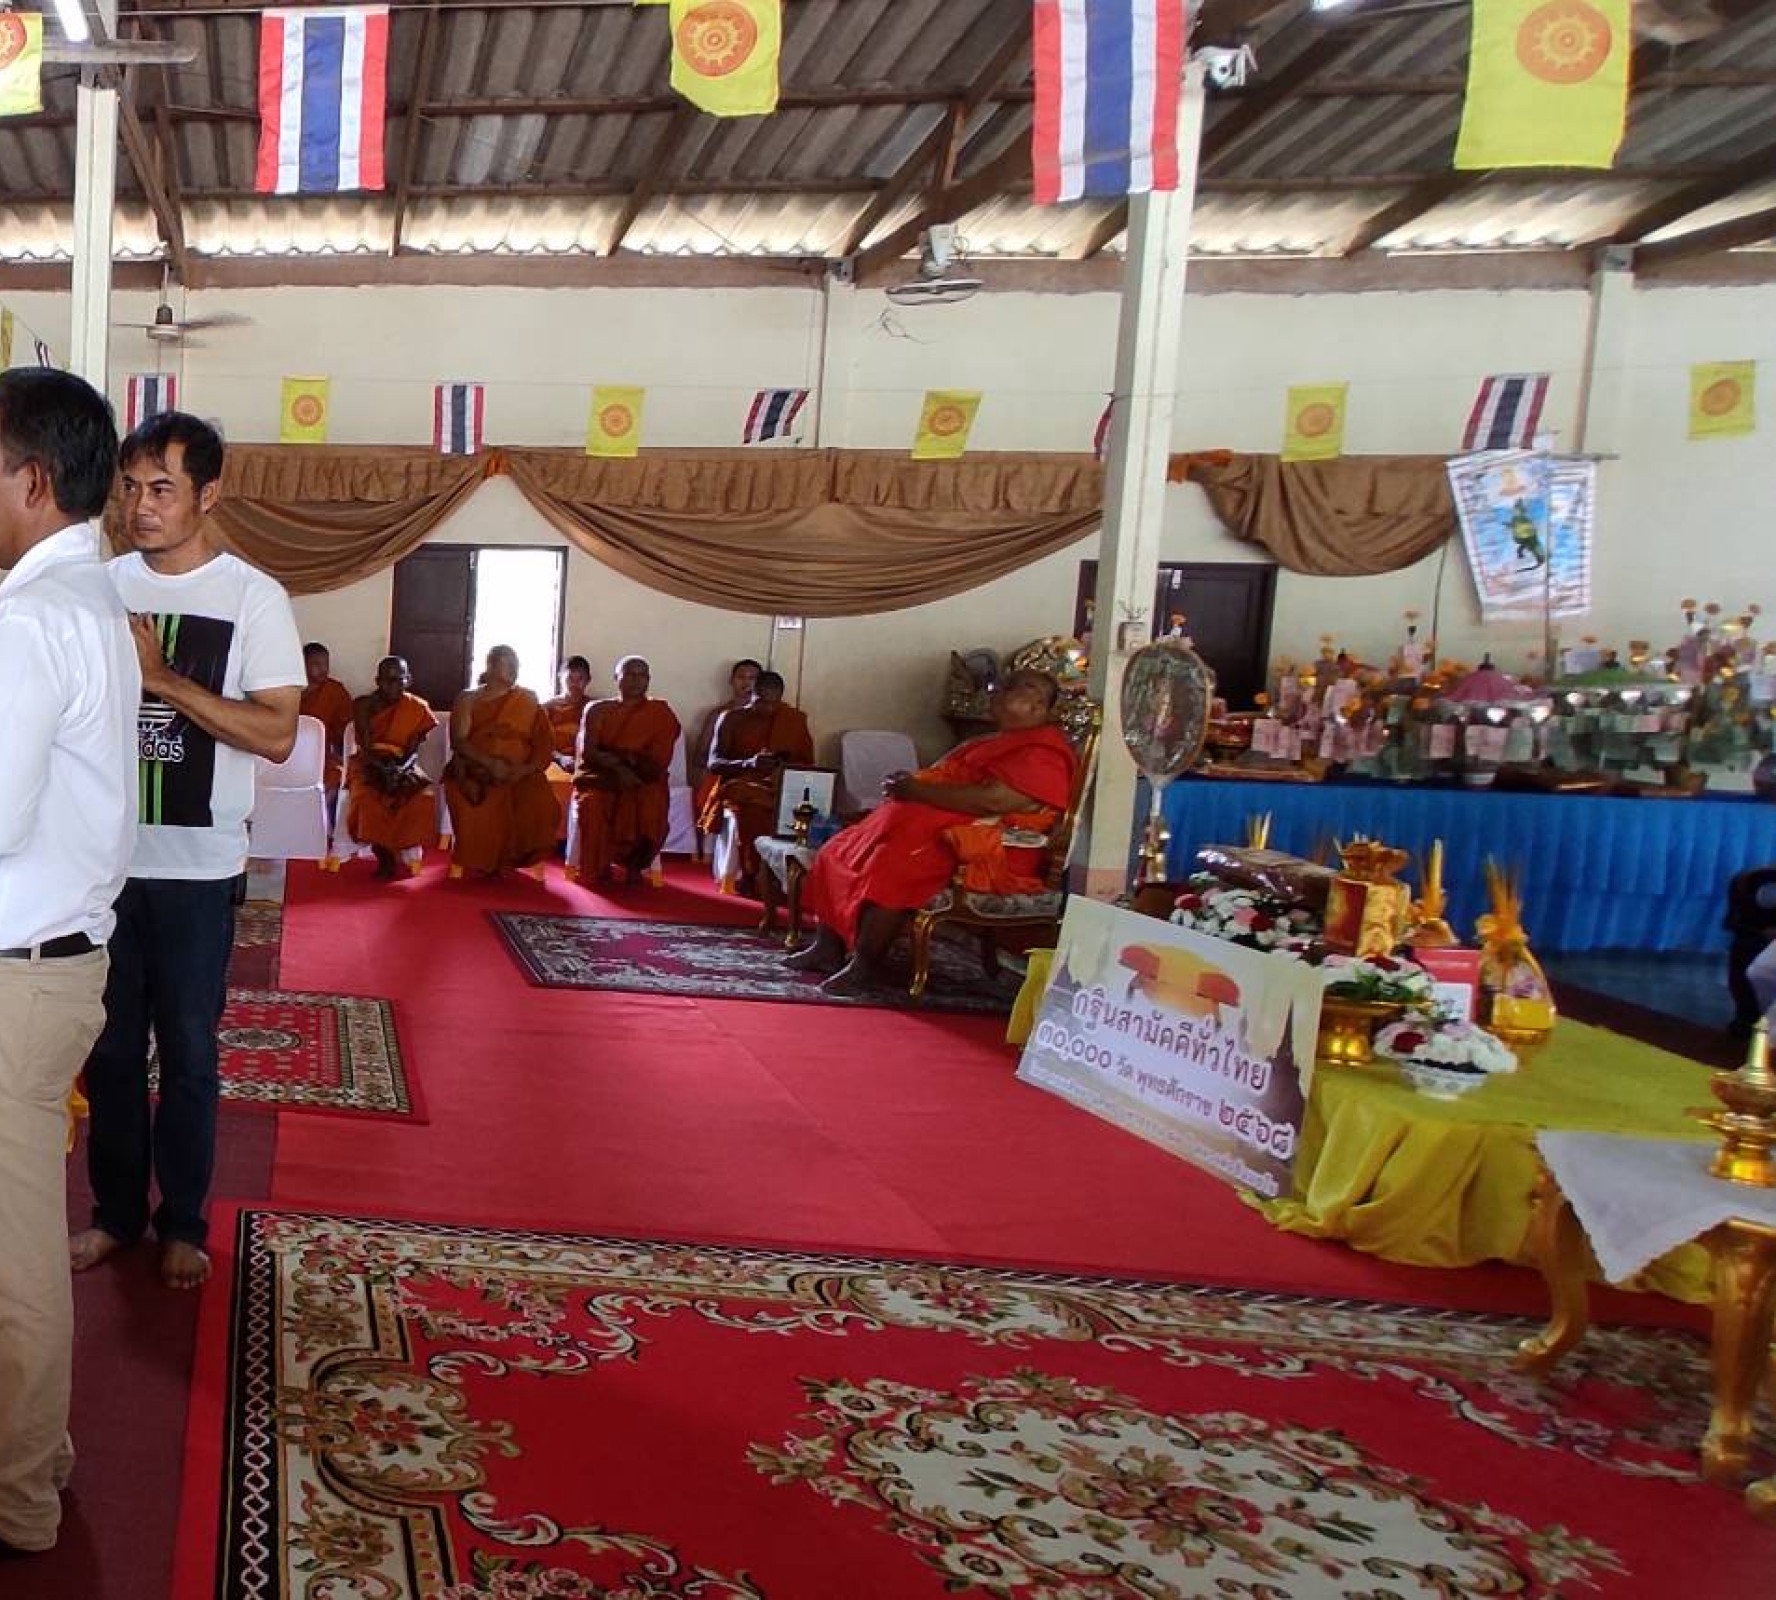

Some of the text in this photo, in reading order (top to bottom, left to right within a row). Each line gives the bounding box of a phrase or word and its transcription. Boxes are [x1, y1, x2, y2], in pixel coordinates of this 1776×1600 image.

[1038, 1024, 1113, 1068] ๓๐,๐๐๐
[1219, 1100, 1292, 1154] ๒๕๖๘
[1072, 986, 1268, 1090] กฐินสามัคคีทั่วไทย
